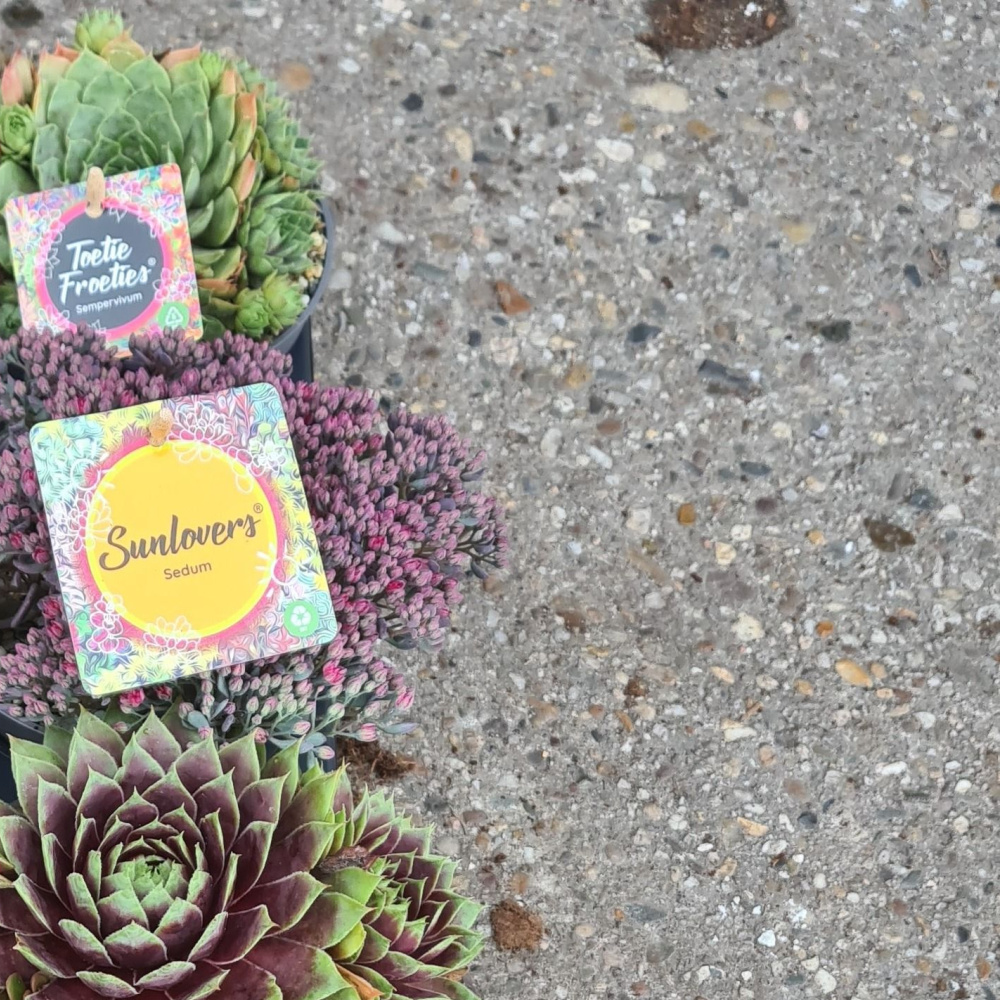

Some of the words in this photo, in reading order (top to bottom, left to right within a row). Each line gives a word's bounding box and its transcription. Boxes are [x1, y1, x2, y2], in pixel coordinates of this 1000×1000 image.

[66, 235, 132, 270] Toetie
[58, 262, 151, 305] Froeties
[76, 292, 142, 315] Sempervivum
[98, 513, 261, 571] Sunlovers
[163, 560, 212, 580] Sedum
